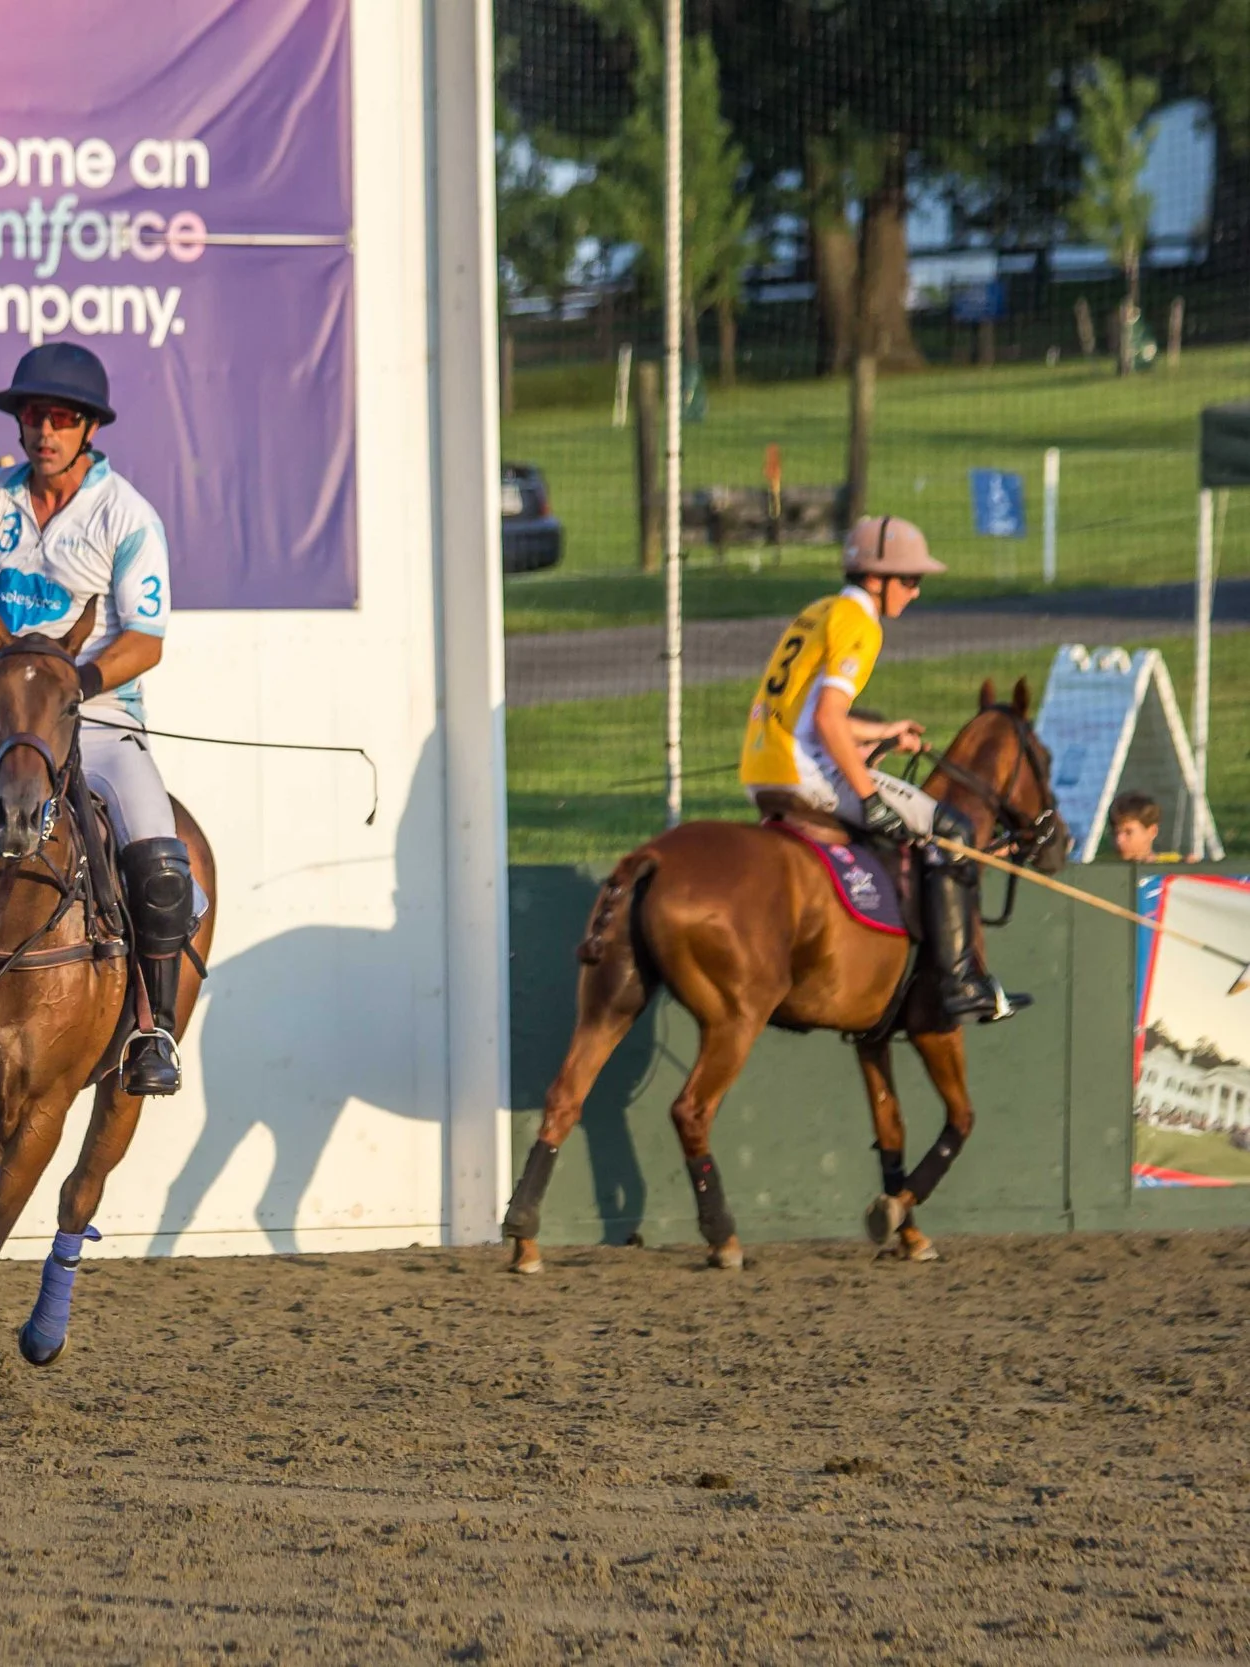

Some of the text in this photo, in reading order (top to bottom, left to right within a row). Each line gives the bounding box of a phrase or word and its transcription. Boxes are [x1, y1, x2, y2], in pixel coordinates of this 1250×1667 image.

[129, 138, 210, 189] an
[137, 575, 162, 618] 3
[767, 635, 804, 695] 3
